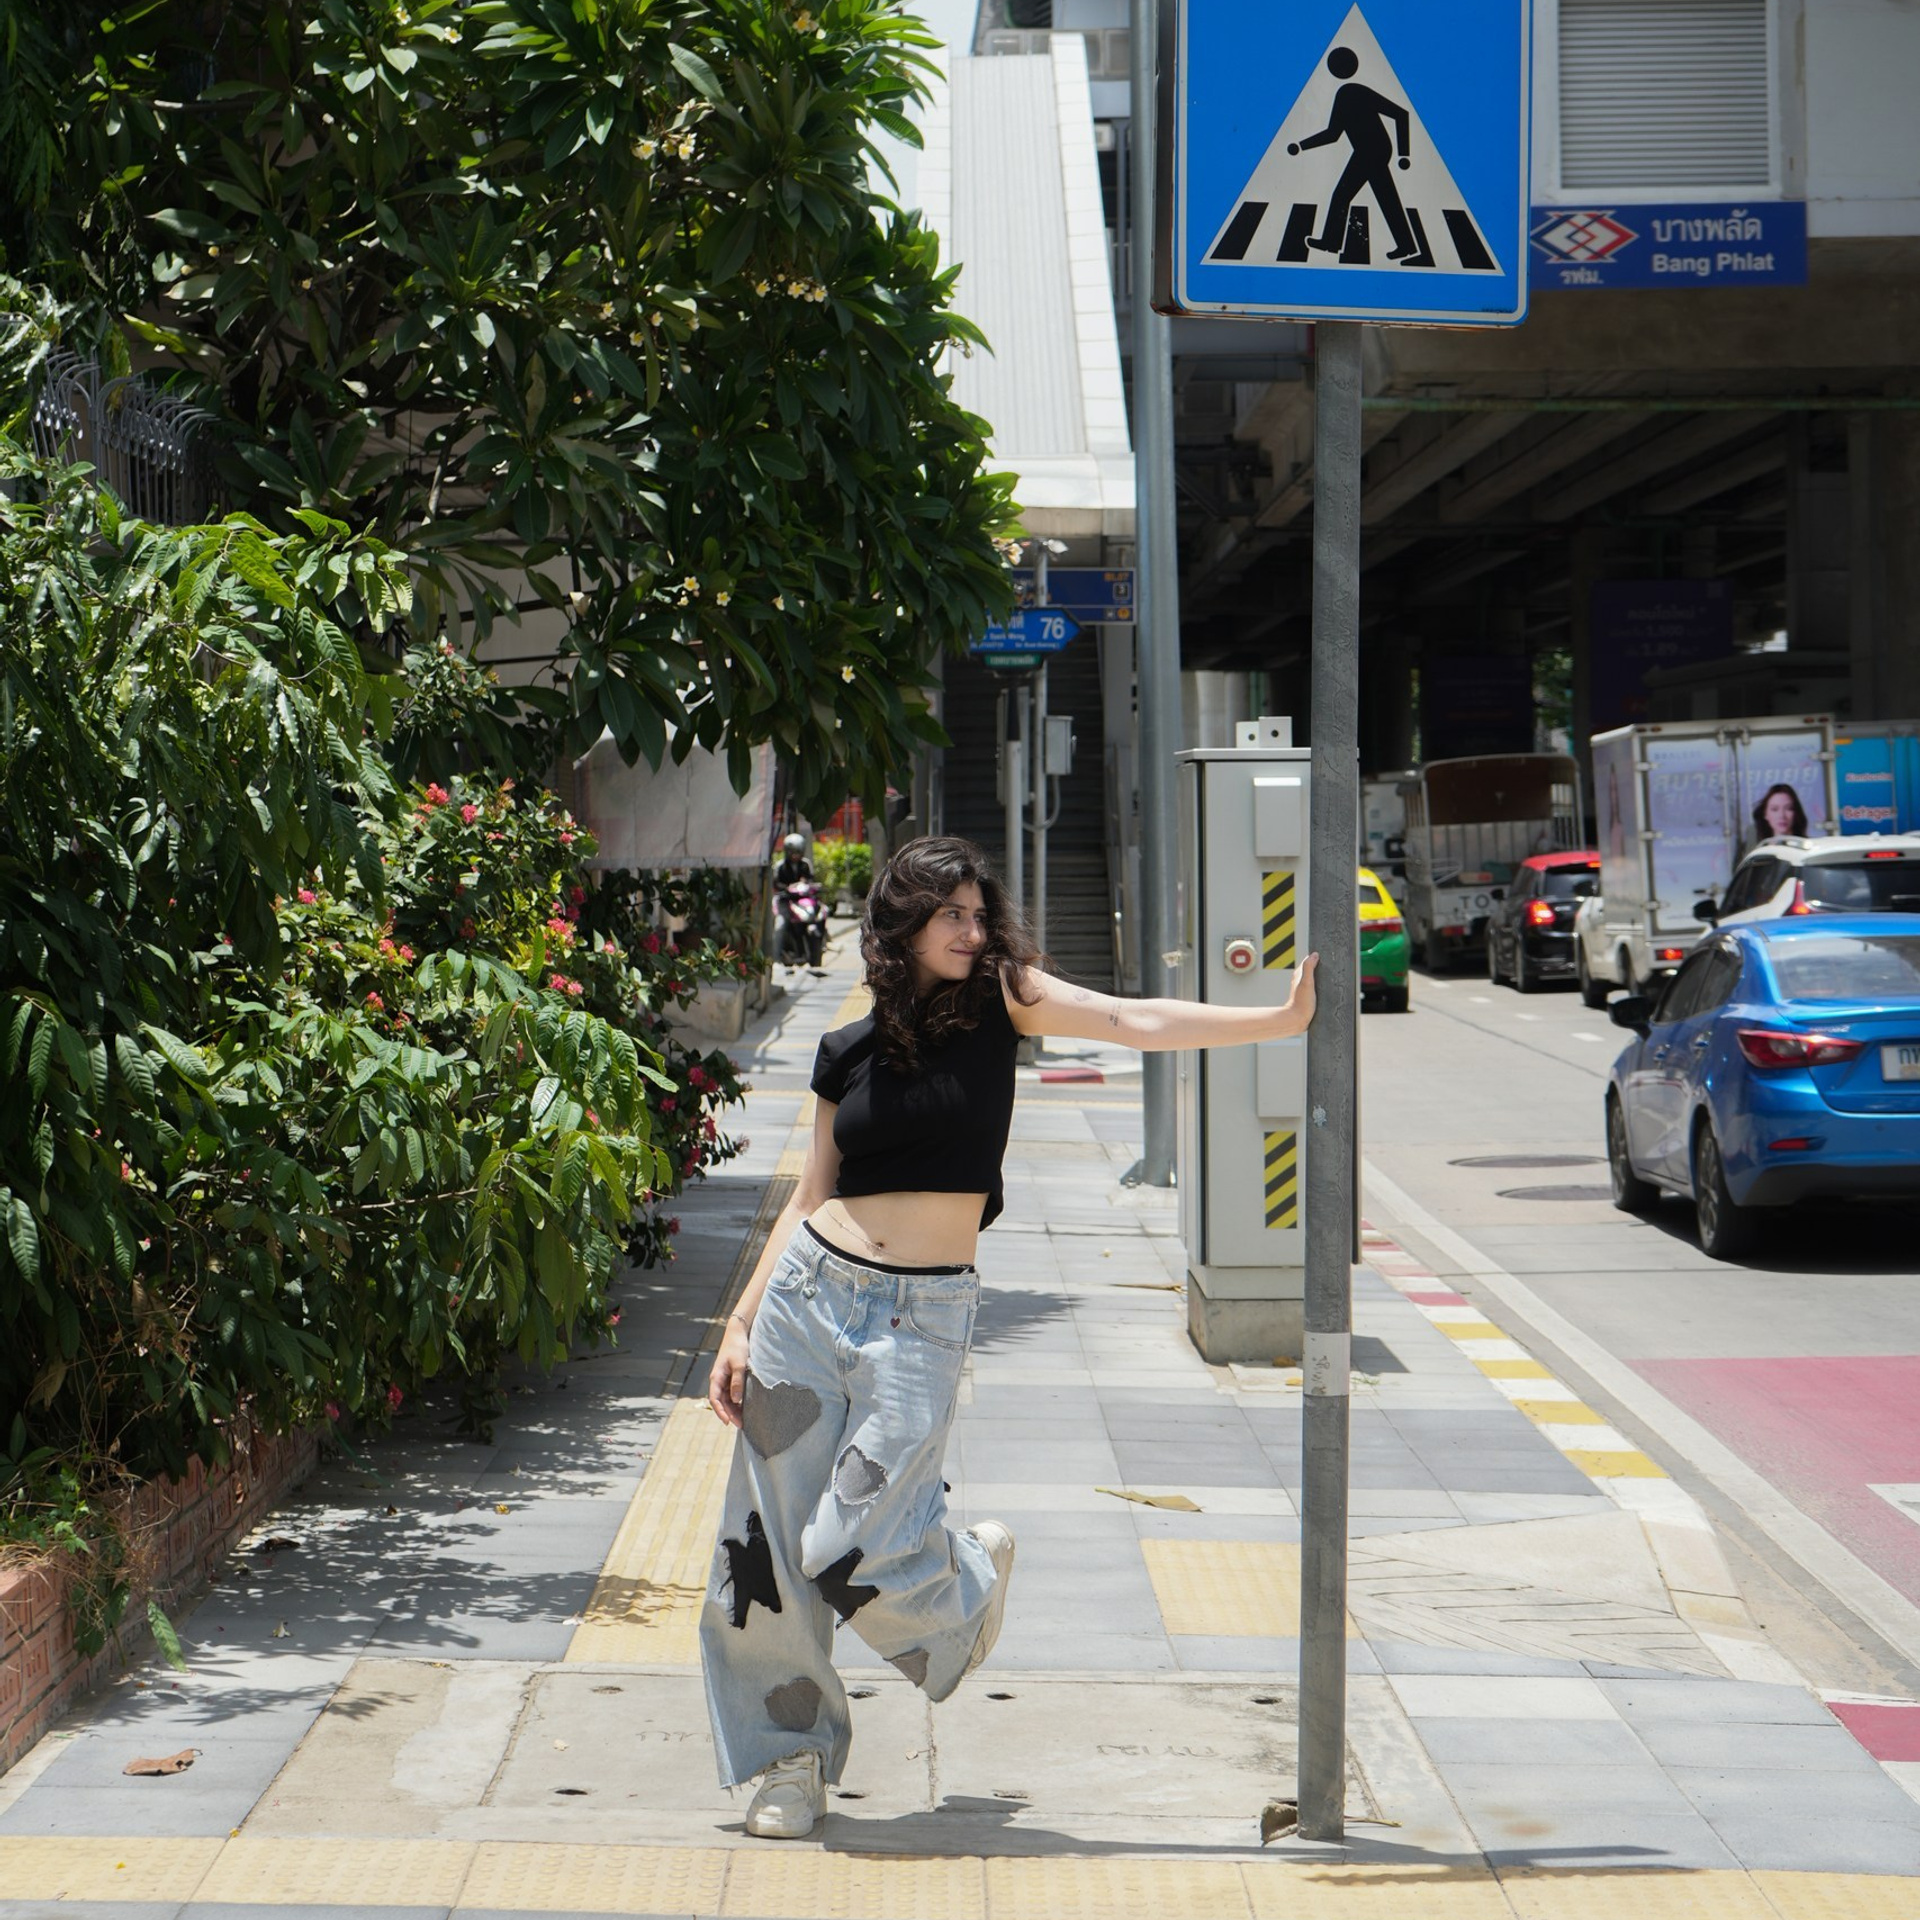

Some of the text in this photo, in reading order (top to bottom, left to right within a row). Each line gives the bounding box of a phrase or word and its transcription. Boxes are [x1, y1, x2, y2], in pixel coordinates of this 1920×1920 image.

[1651, 209, 1763, 243] บางพลัด
[1651, 252, 1774, 276] Bang Phlat
[1040, 616, 1065, 640] 76
